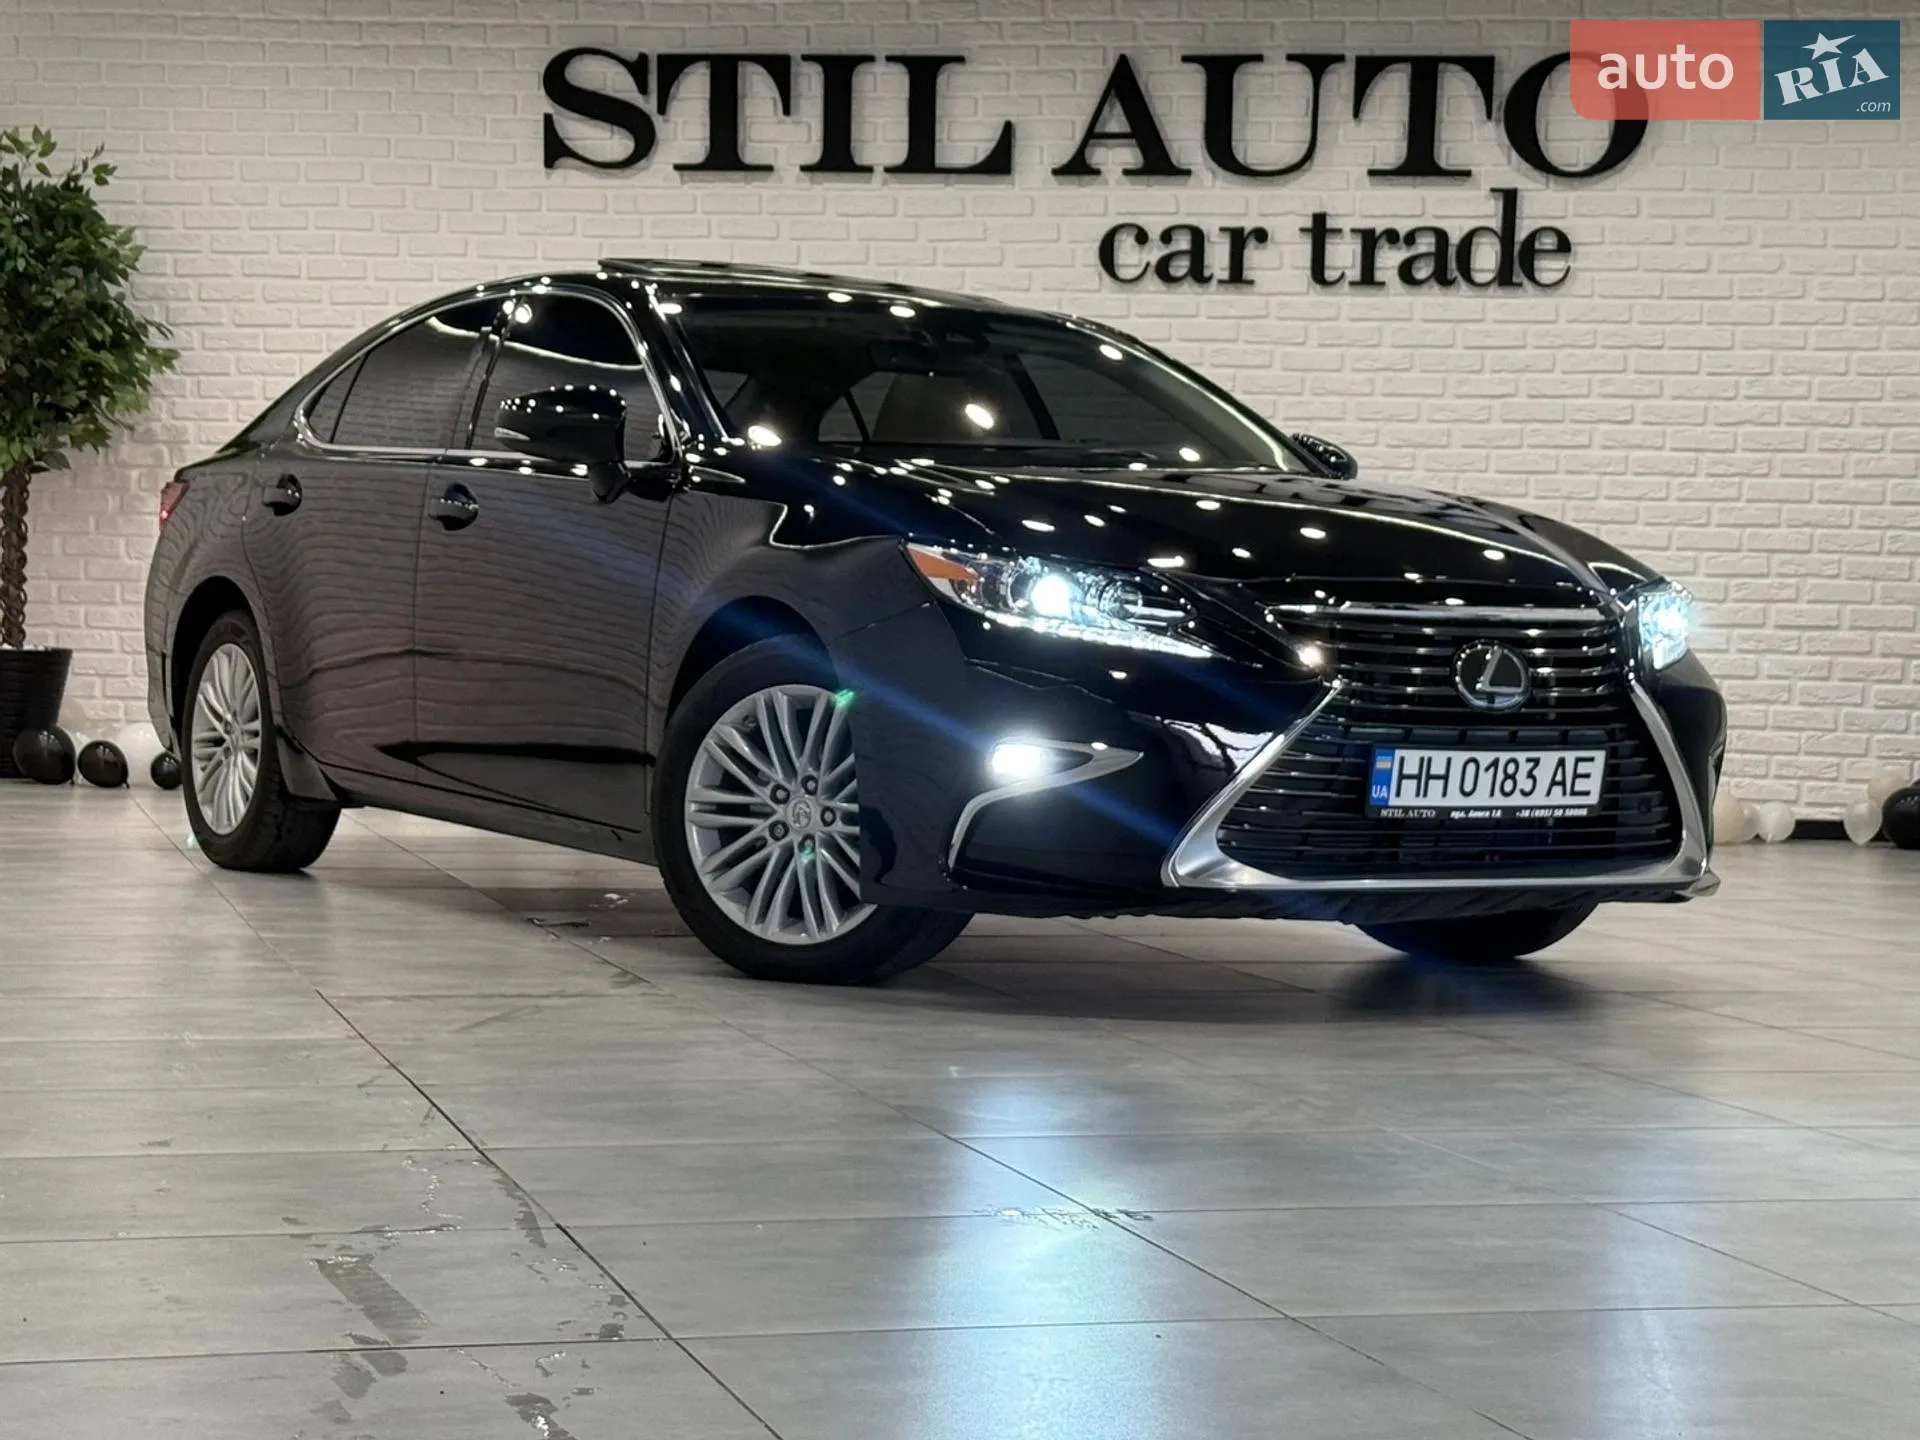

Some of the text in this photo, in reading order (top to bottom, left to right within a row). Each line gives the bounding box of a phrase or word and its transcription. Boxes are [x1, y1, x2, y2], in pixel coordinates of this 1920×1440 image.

[543, 47, 1649, 178] STIL AUTO
[1099, 187, 1572, 288] car trade
[1371, 785, 1388, 799] UA
[1395, 756, 1596, 798] HH 0183 AE
[1406, 808, 1436, 818] AUTO
